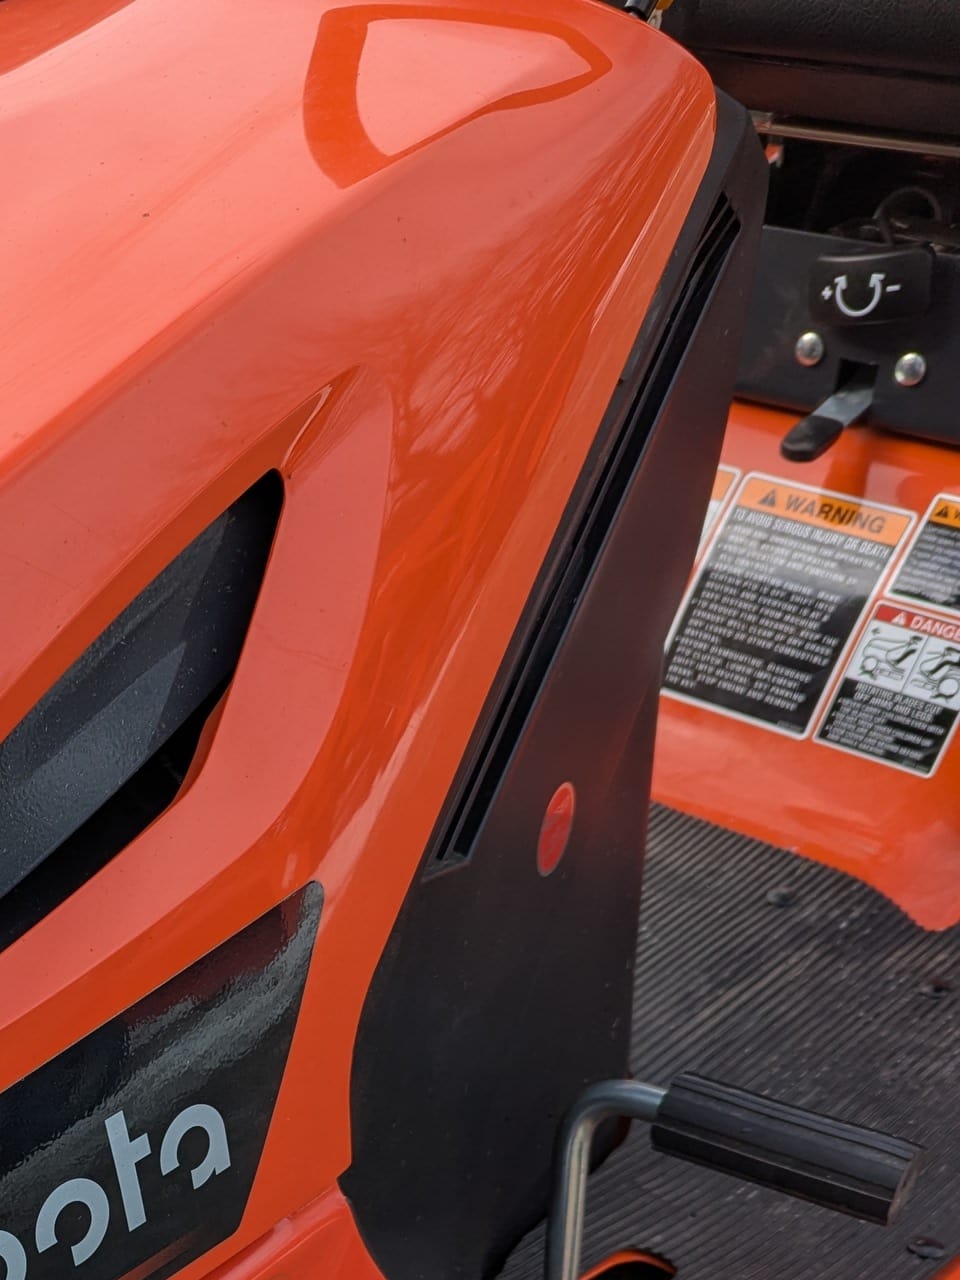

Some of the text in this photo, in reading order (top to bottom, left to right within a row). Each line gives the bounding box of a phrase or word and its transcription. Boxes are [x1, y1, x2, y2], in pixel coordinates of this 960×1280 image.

[733, 508, 746, 520] TO
[744, 511, 772, 527] AVOID
[772, 519, 811, 537] SERIOUS
[809, 529, 844, 546] INJURY
[841, 538, 859, 550] OR
[786, 494, 886, 534] WARNING
